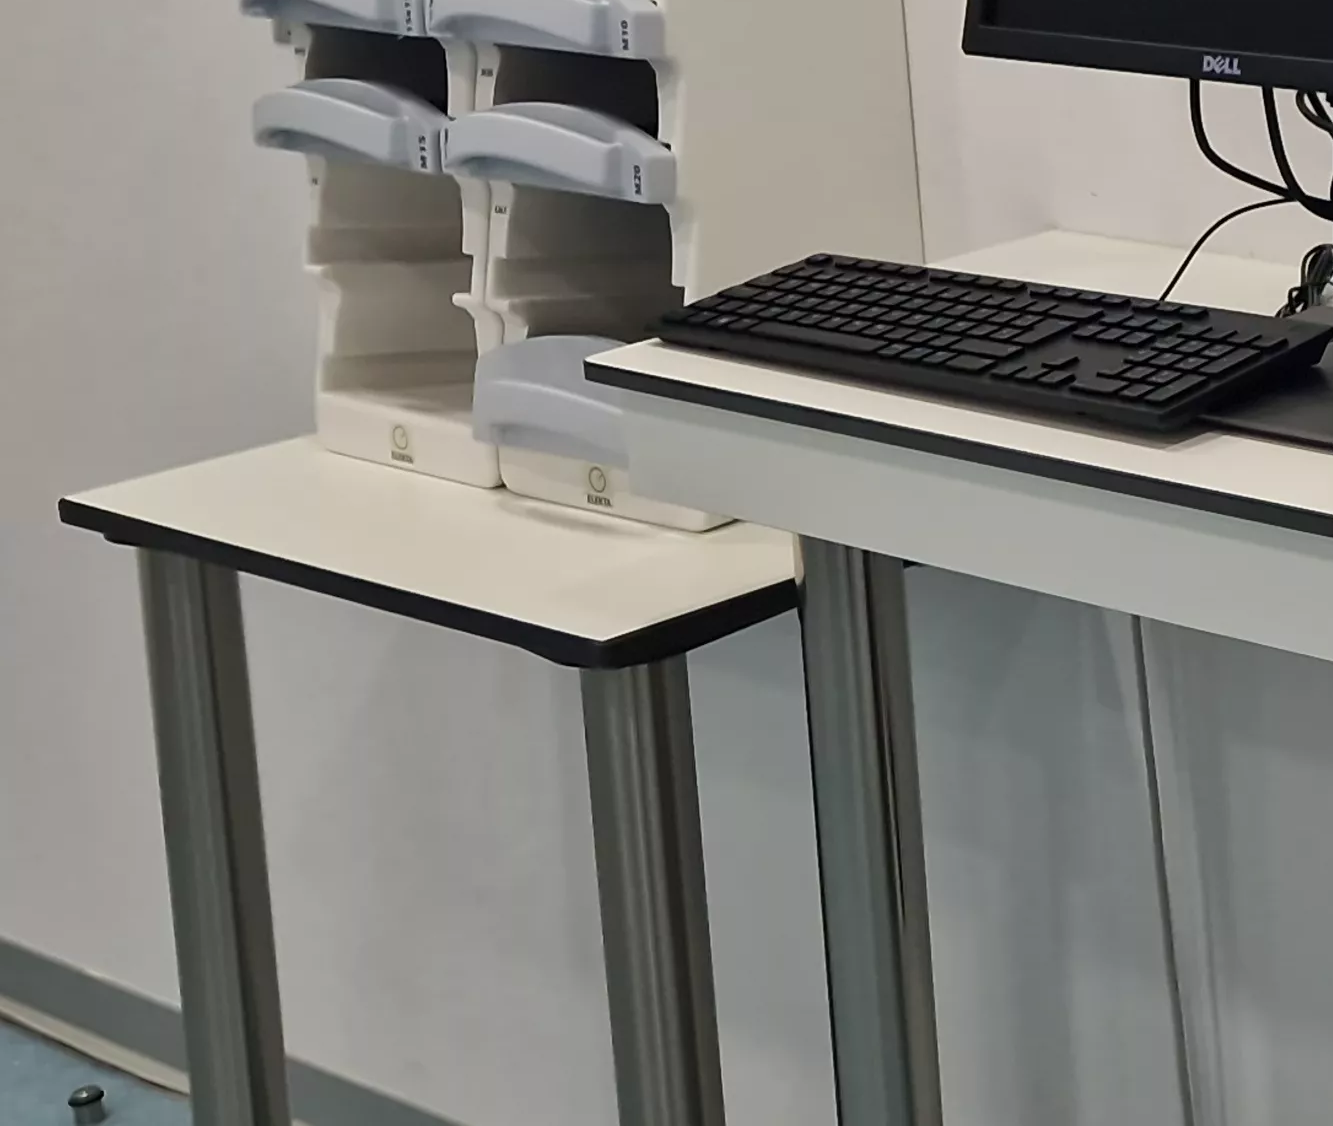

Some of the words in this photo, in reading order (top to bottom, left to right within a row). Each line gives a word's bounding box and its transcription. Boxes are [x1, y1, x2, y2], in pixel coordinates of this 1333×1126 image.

[620, 19, 630, 51] M10
[1203, 55, 1241, 74] DELL
[418, 135, 428, 170] M15
[633, 164, 643, 196] M20
